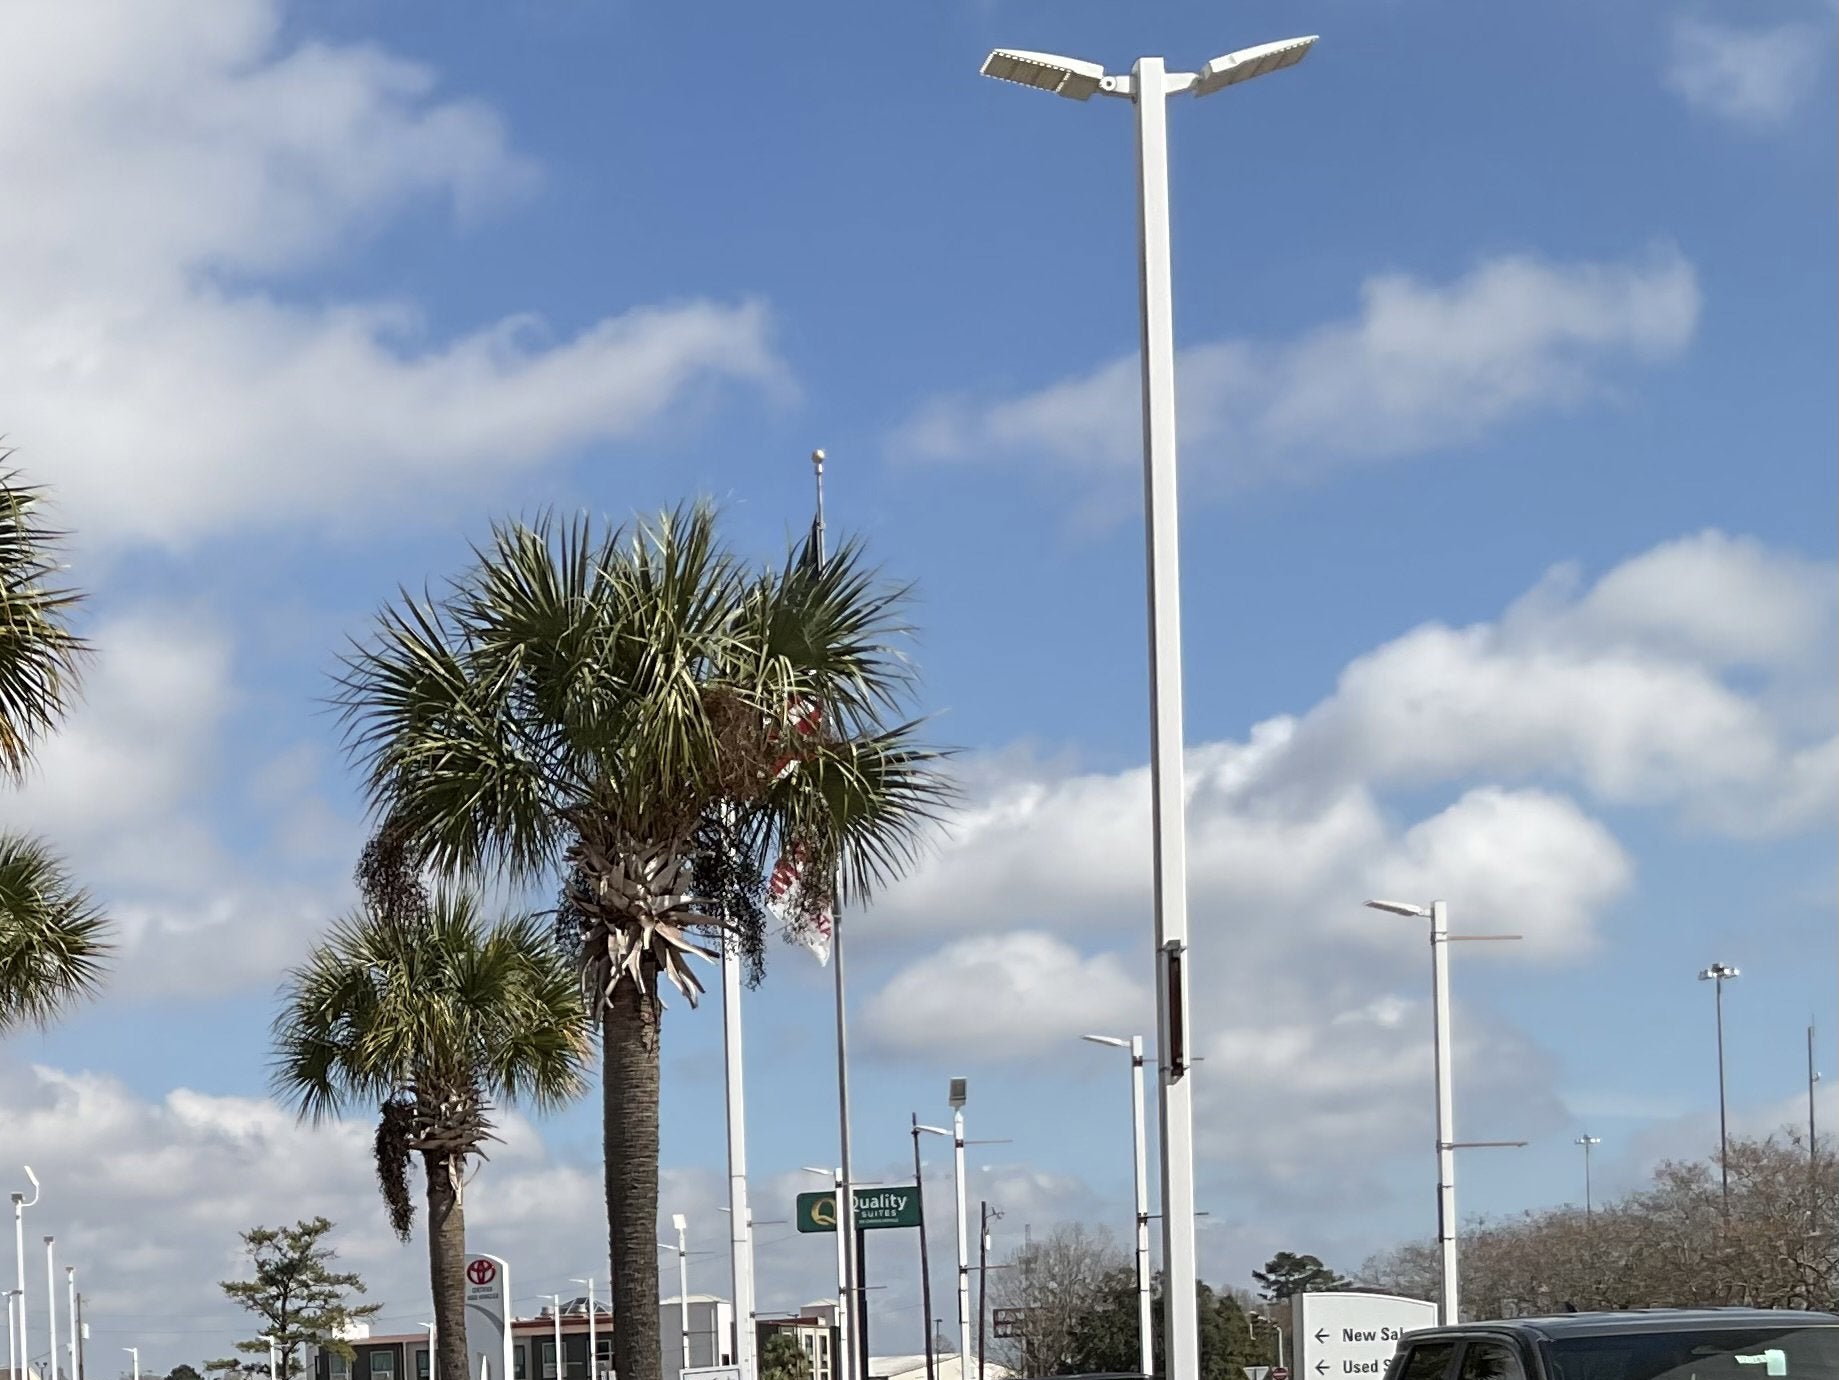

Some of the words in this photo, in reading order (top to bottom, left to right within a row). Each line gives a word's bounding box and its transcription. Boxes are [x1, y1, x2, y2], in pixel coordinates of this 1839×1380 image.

[861, 1209, 897, 1218] SUITES
[1342, 1328, 1376, 1342] New
[1380, 1327, 1404, 1341] Sal
[1343, 1359, 1379, 1373] Used
